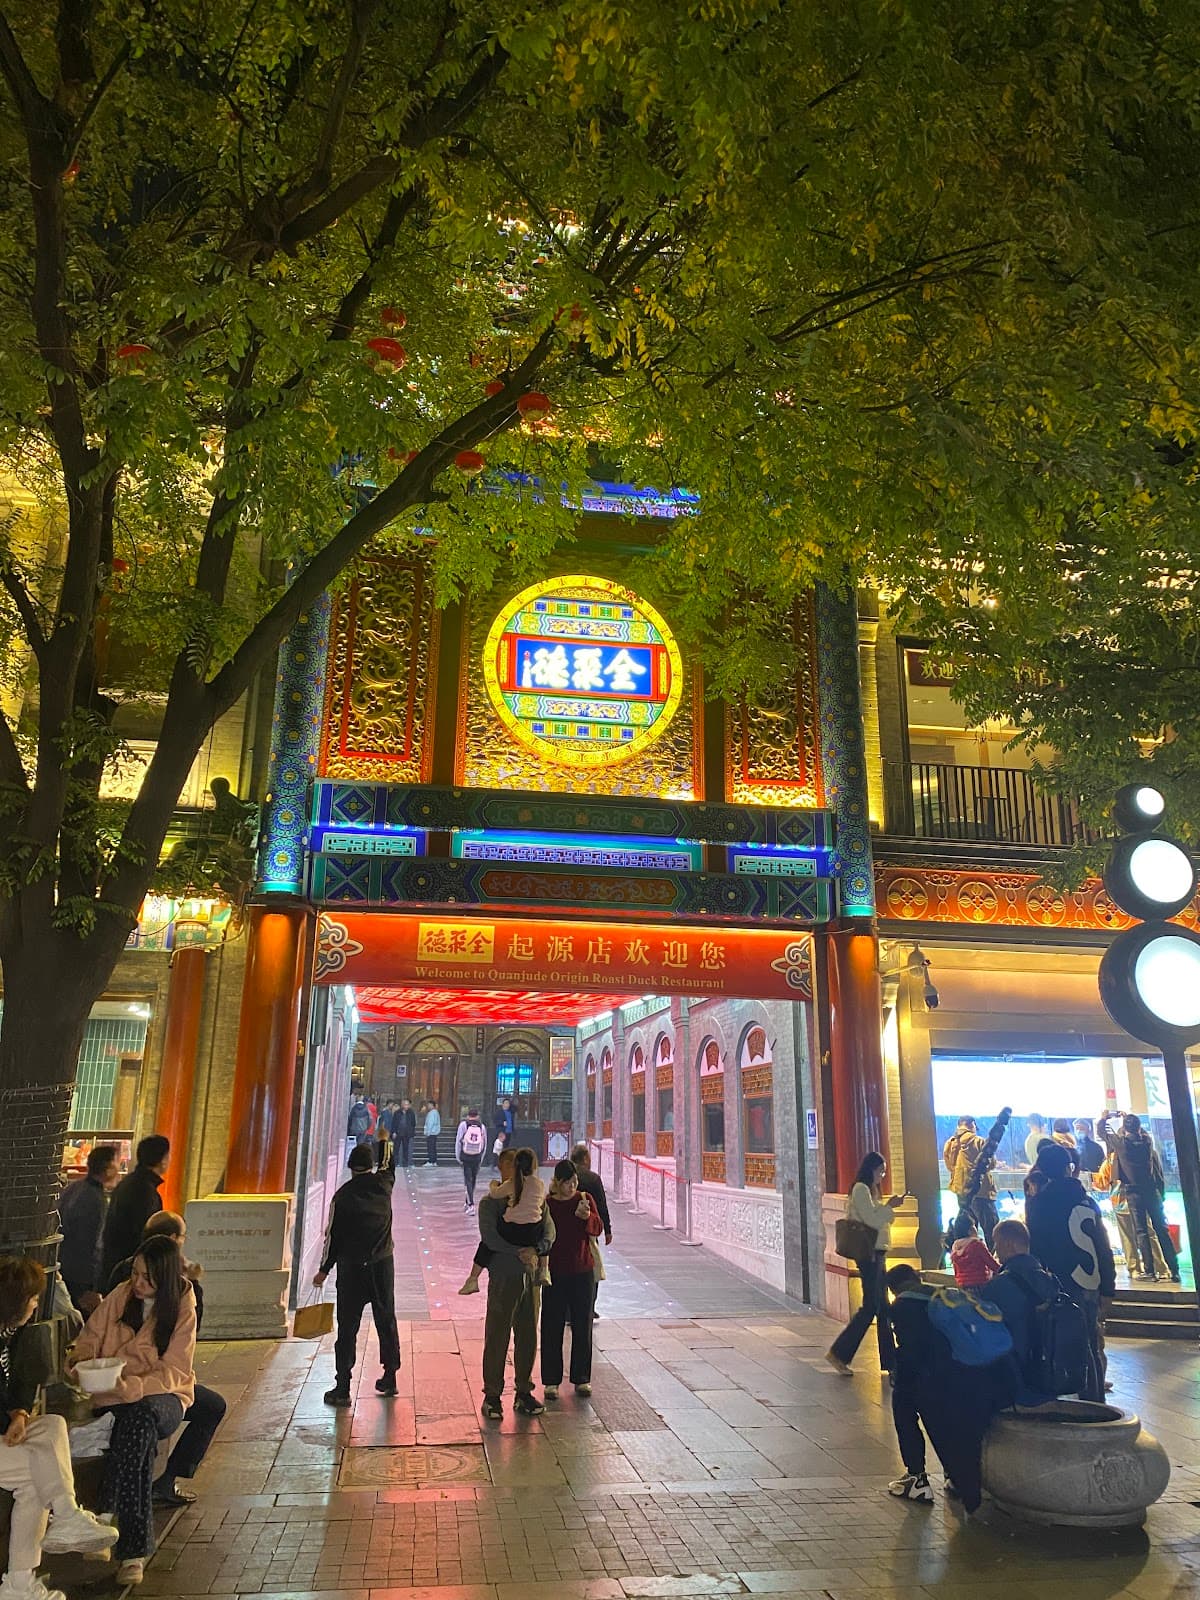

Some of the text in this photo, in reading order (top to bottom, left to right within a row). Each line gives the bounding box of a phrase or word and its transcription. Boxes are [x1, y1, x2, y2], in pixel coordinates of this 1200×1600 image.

[507, 933, 726, 970] 起源店欢迎您
[415, 966, 724, 988] Welcome to Quanjude Origin Roast Duck Restaurant
